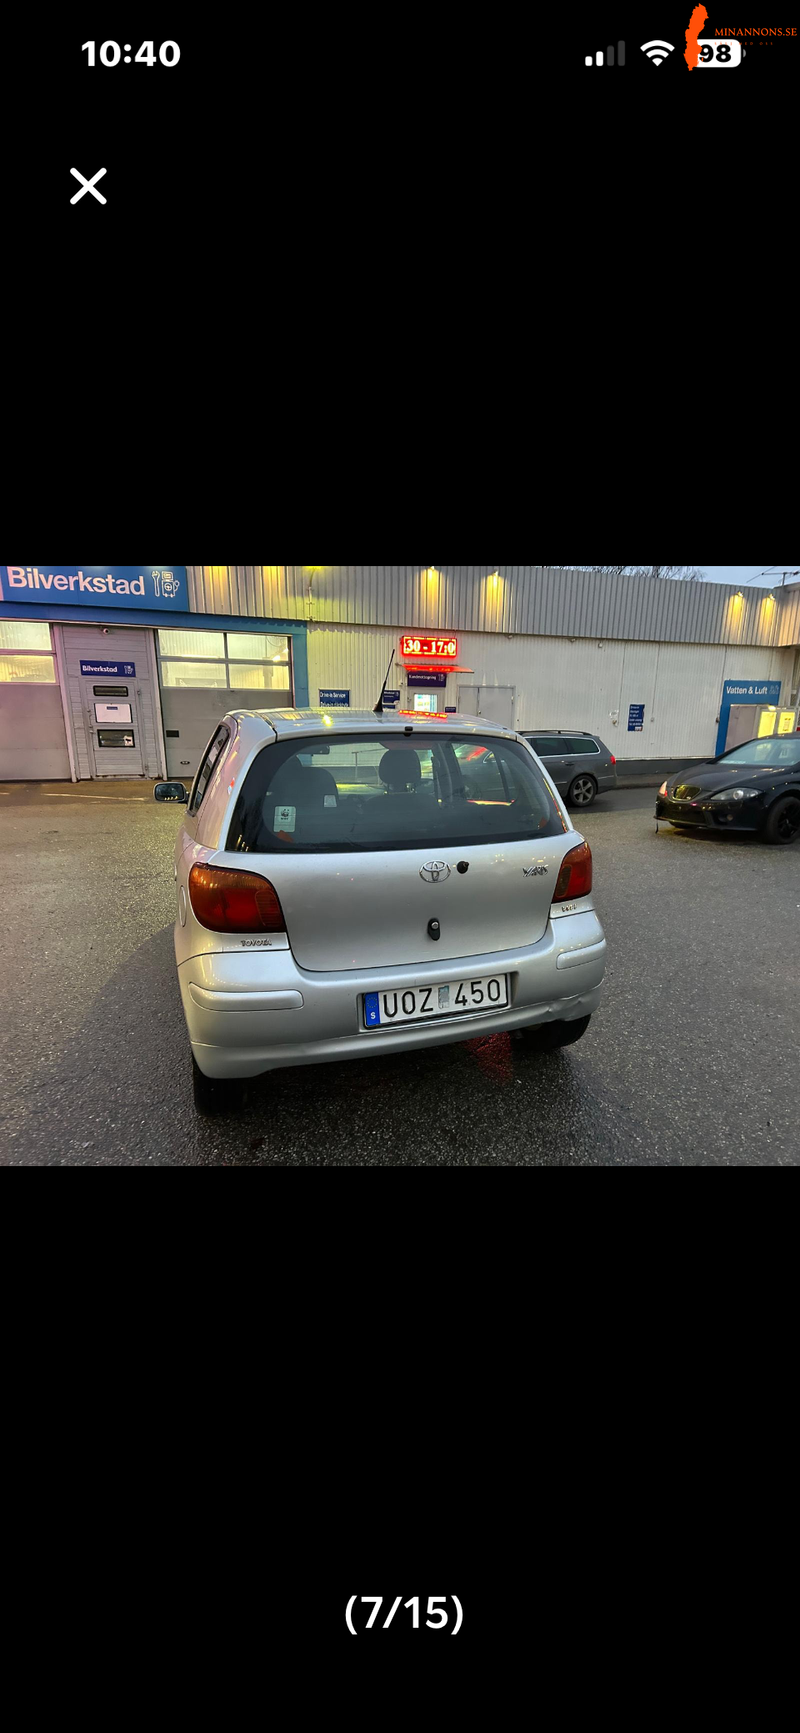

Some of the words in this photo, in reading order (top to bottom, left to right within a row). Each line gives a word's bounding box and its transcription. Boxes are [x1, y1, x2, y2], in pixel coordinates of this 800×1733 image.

[7, 566, 146, 596] Bilverkstad
[82, 665, 118, 673] Bilverkstad
[726, 685, 747, 695] Vatten
[747, 686, 754, 695] &
[754, 686, 768, 695] Luft
[240, 938, 272, 947] TOYOTA
[383, 987, 434, 1018] UOZ
[454, 979, 501, 1007] 450
[370, 1011, 376, 1020] S
